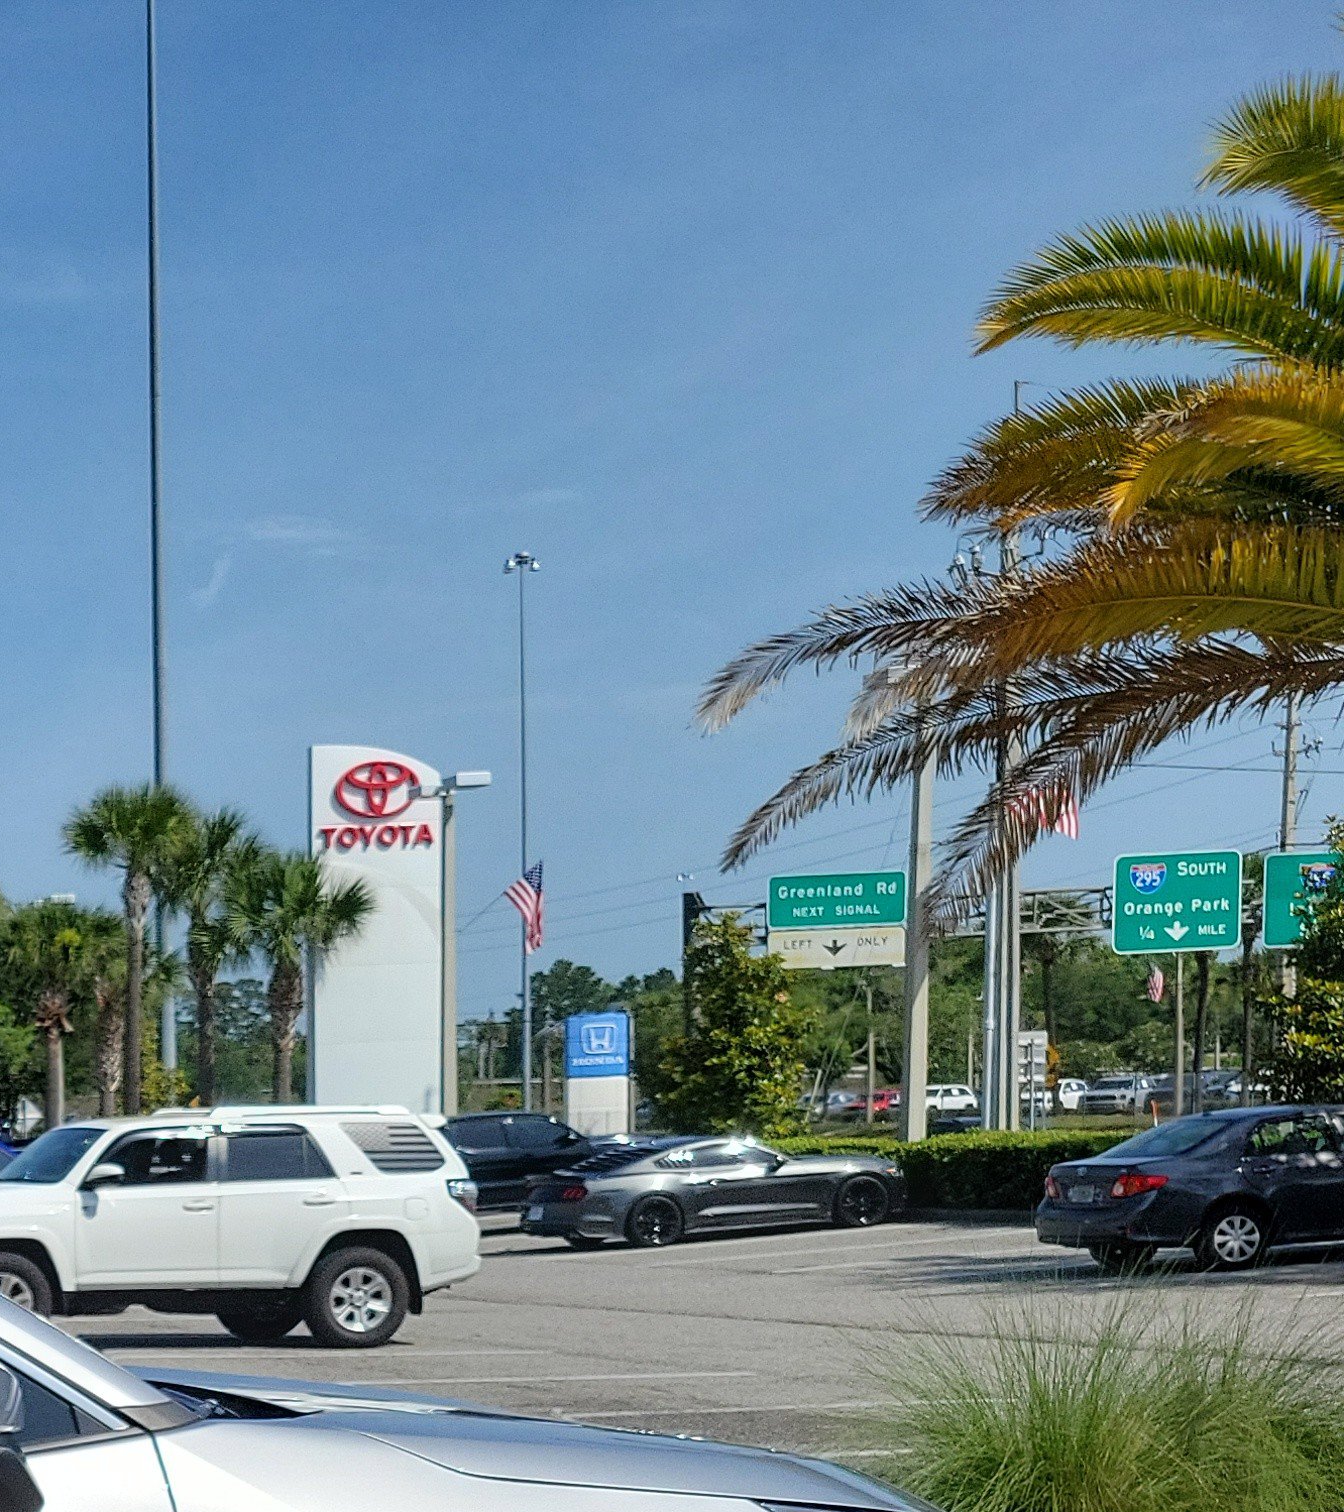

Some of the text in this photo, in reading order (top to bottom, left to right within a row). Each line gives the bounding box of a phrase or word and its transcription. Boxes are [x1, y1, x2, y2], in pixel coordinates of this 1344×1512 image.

[319, 823, 433, 849] TOYOTA
[1135, 871, 1161, 888] 295
[1177, 861, 1227, 876] SOUTH
[777, 881, 898, 899] Greenland Rd
[792, 904, 881, 918] NEXT SIGNAL
[1123, 897, 1230, 917] Orange Park
[1197, 923, 1227, 936] MILE
[783, 935, 889, 950] LEFT ONLY
